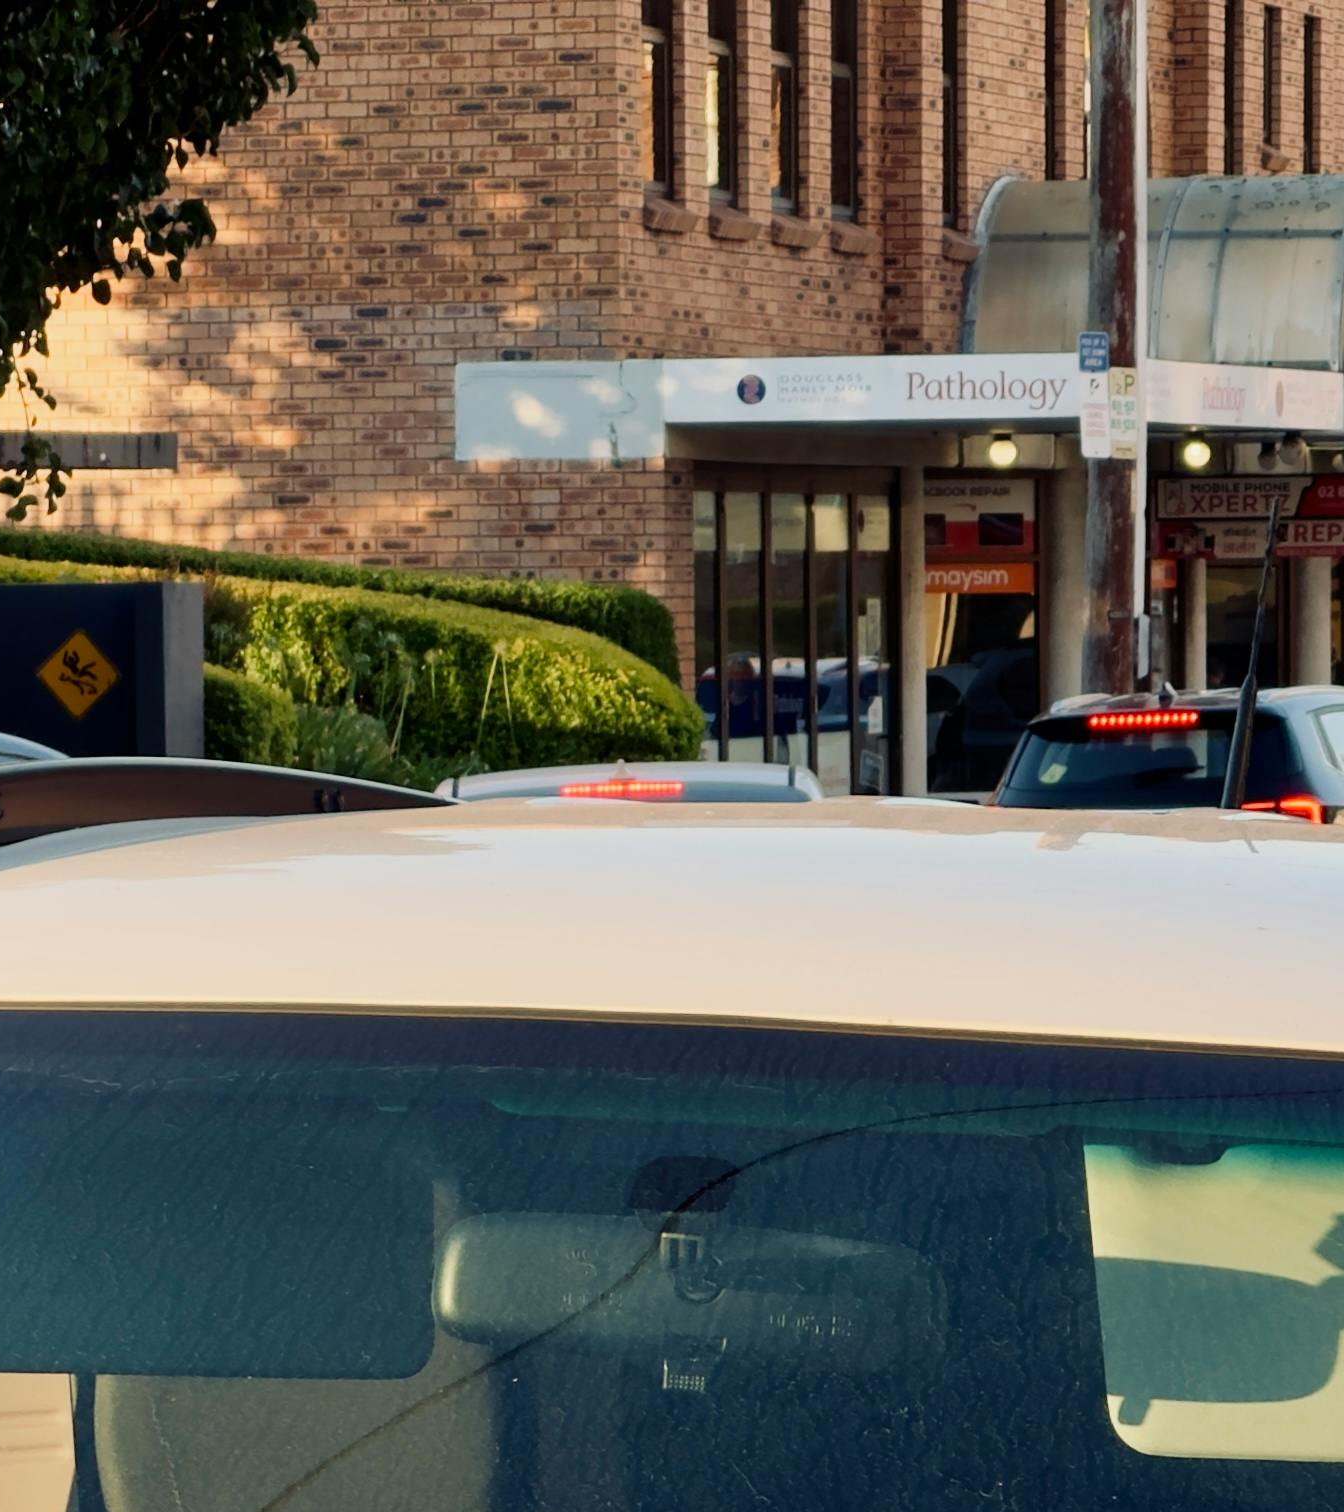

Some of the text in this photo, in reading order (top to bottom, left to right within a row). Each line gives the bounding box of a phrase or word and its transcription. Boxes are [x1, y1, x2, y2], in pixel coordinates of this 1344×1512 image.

[906, 370, 1068, 411] Pathology
[1190, 482, 1290, 494] MOBILE PHONE
[1318, 485, 1335, 498] 02
[1191, 494, 1291, 513] XPERTZ
